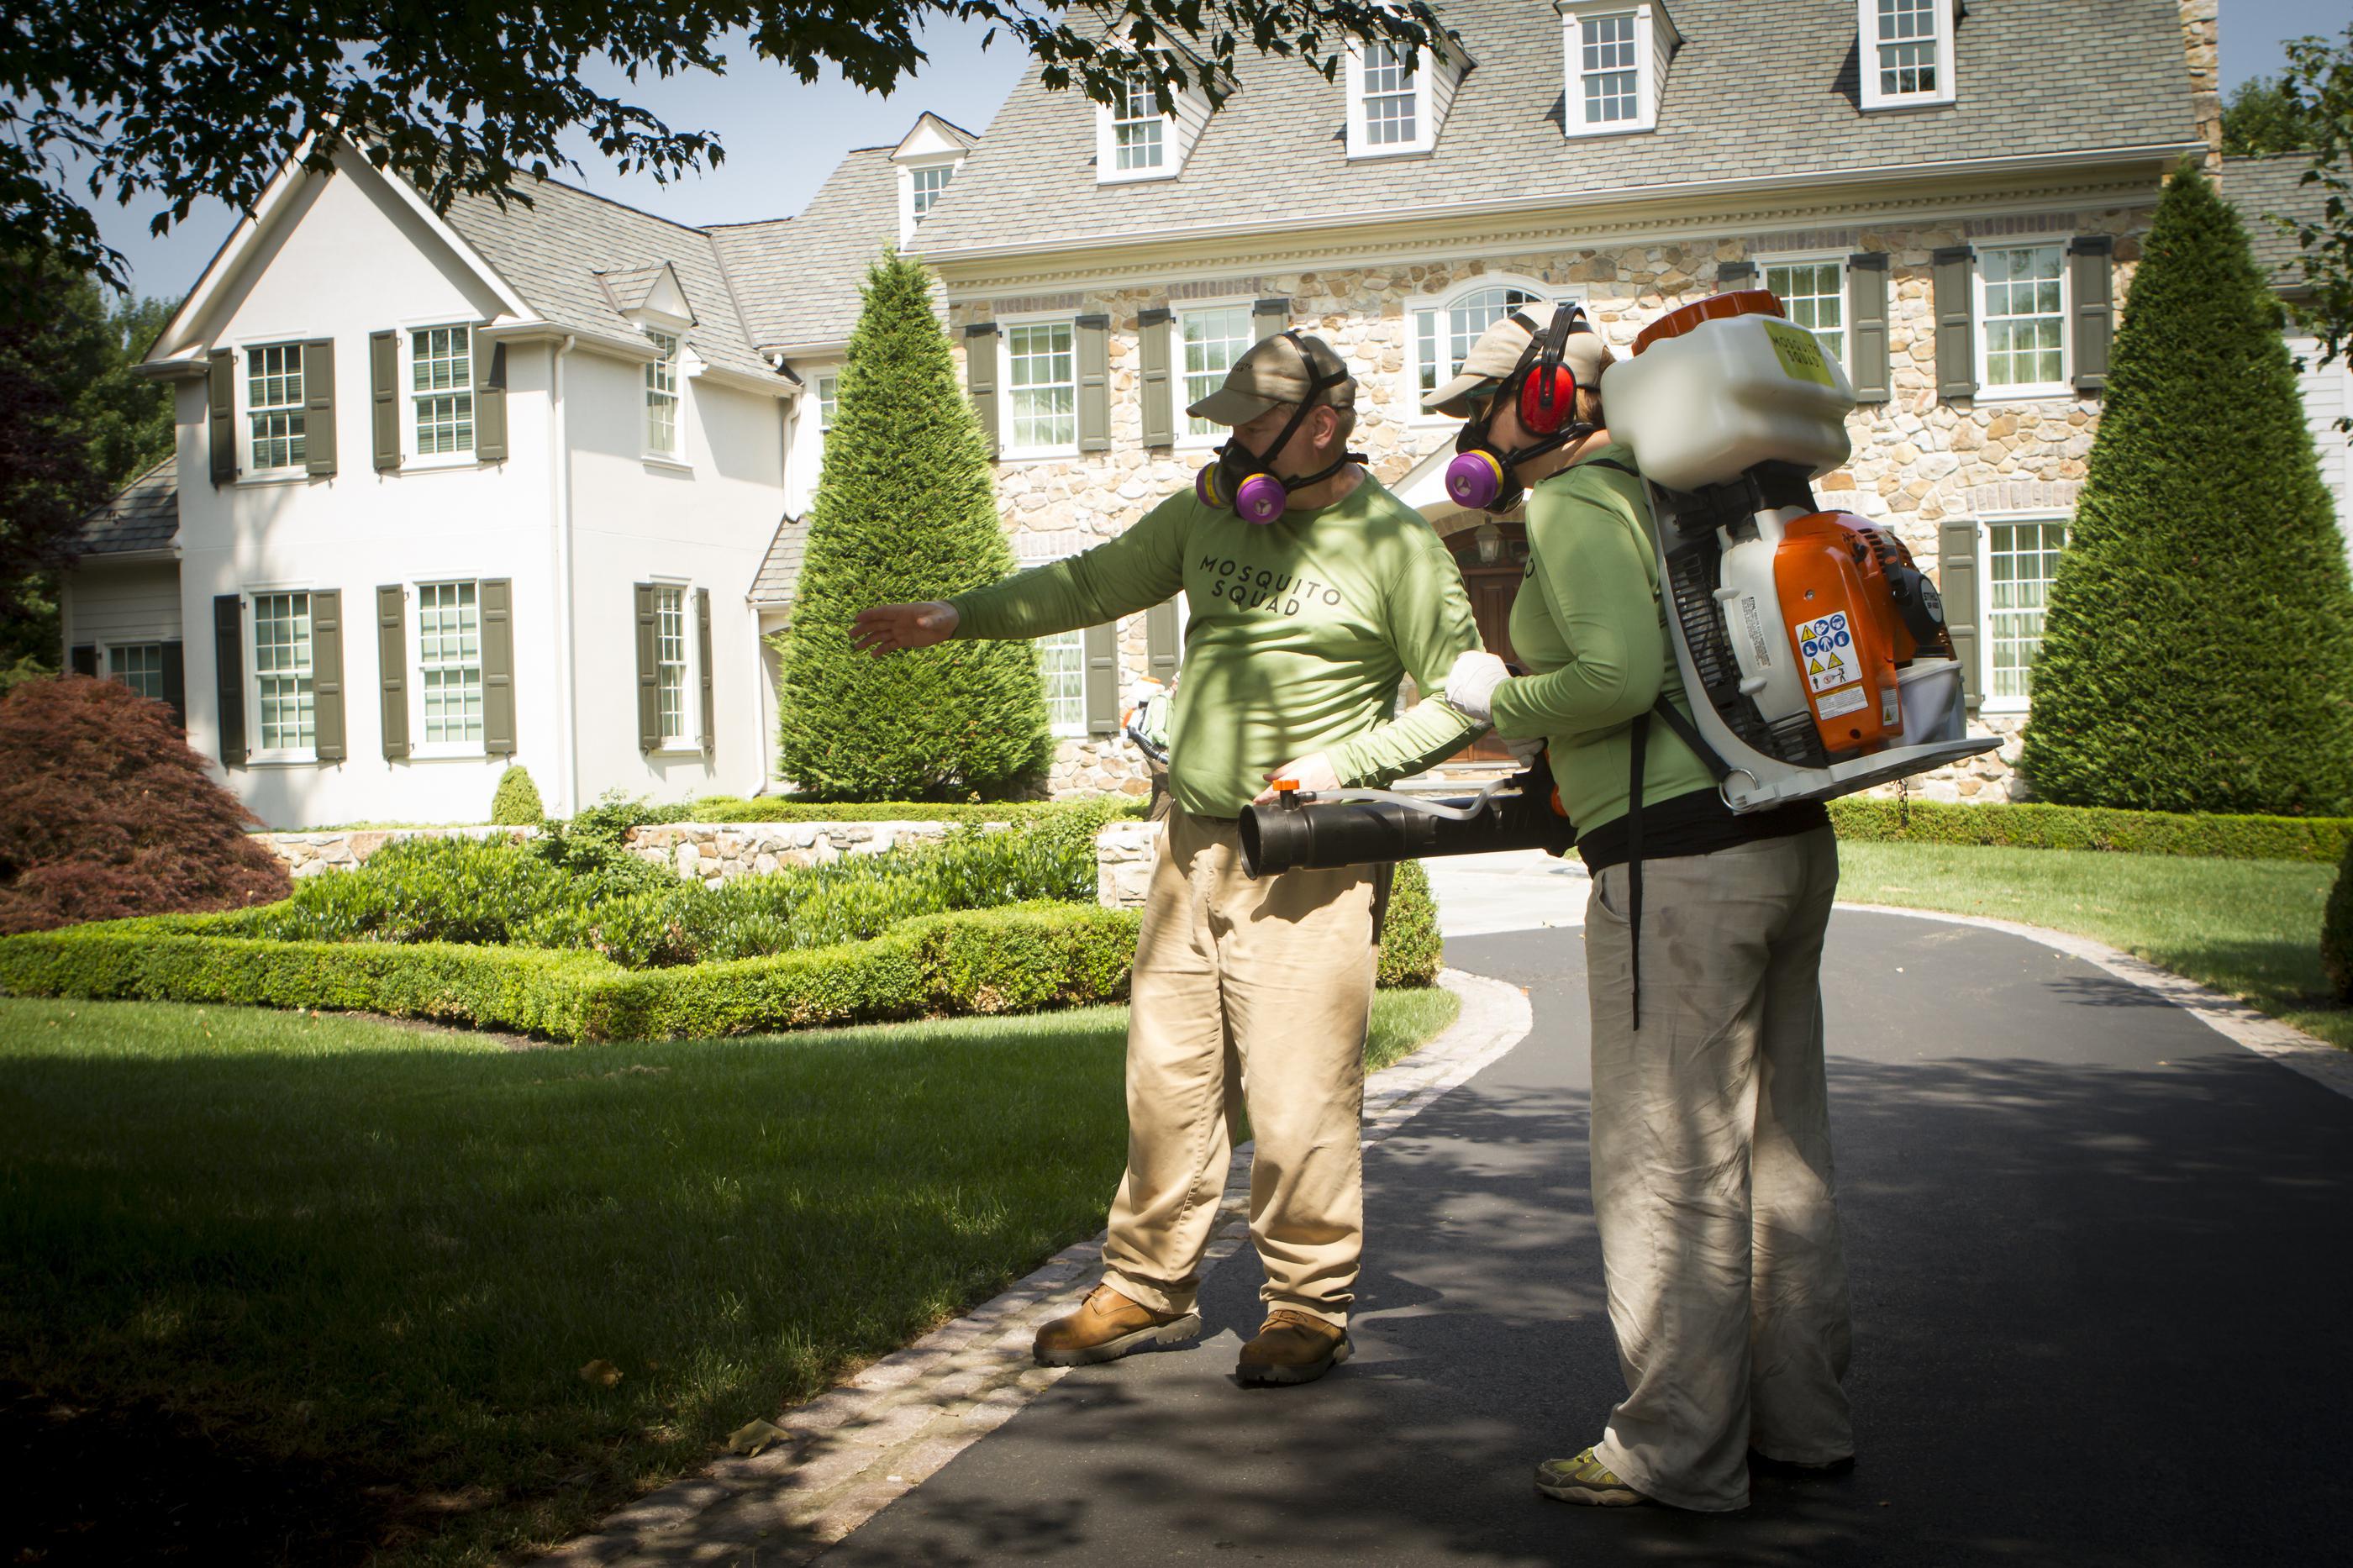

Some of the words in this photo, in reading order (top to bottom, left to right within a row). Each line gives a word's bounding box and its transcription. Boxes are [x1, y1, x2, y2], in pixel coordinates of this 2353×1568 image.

[1771, 335, 1821, 357] MOSQUITO
[1787, 350, 1819, 367] SQUAD
[1199, 555, 1342, 606] MOSQUITO
[1212, 580, 1300, 617] SQUAD
[1924, 592, 1938, 601] STIHL
